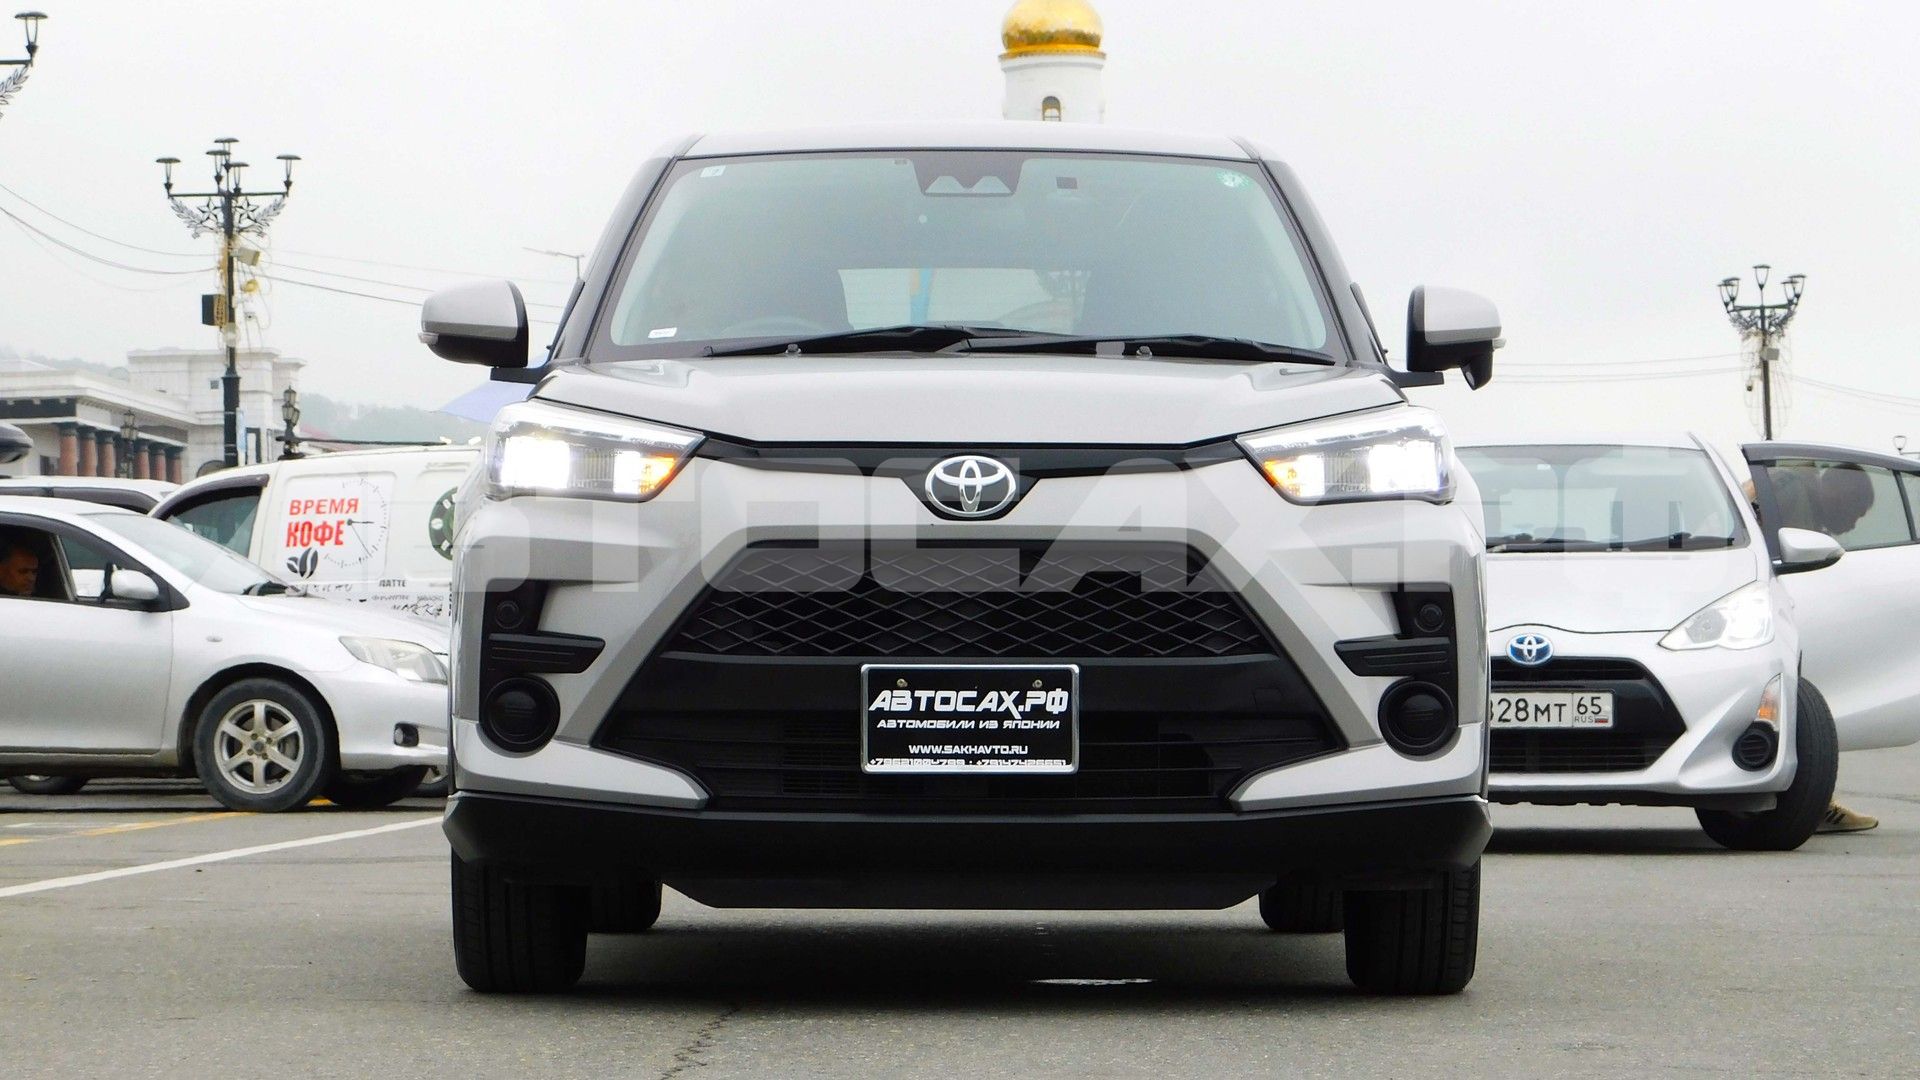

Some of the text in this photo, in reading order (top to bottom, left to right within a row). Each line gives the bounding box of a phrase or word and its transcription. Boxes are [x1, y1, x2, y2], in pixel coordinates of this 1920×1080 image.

[289, 498, 359, 516] ВРЕМЯ
[286, 520, 345, 548] КОФЕ
[869, 688, 1069, 720] АВТОСАХ.РФ
[1490, 697, 1602, 723] 28МТ 65
[877, 719, 1060, 729] АВТОМОБИЛИ ИЗ ЯПОНИИ
[908, 745, 1028, 755] WWW.SAKHAVTO.RU
